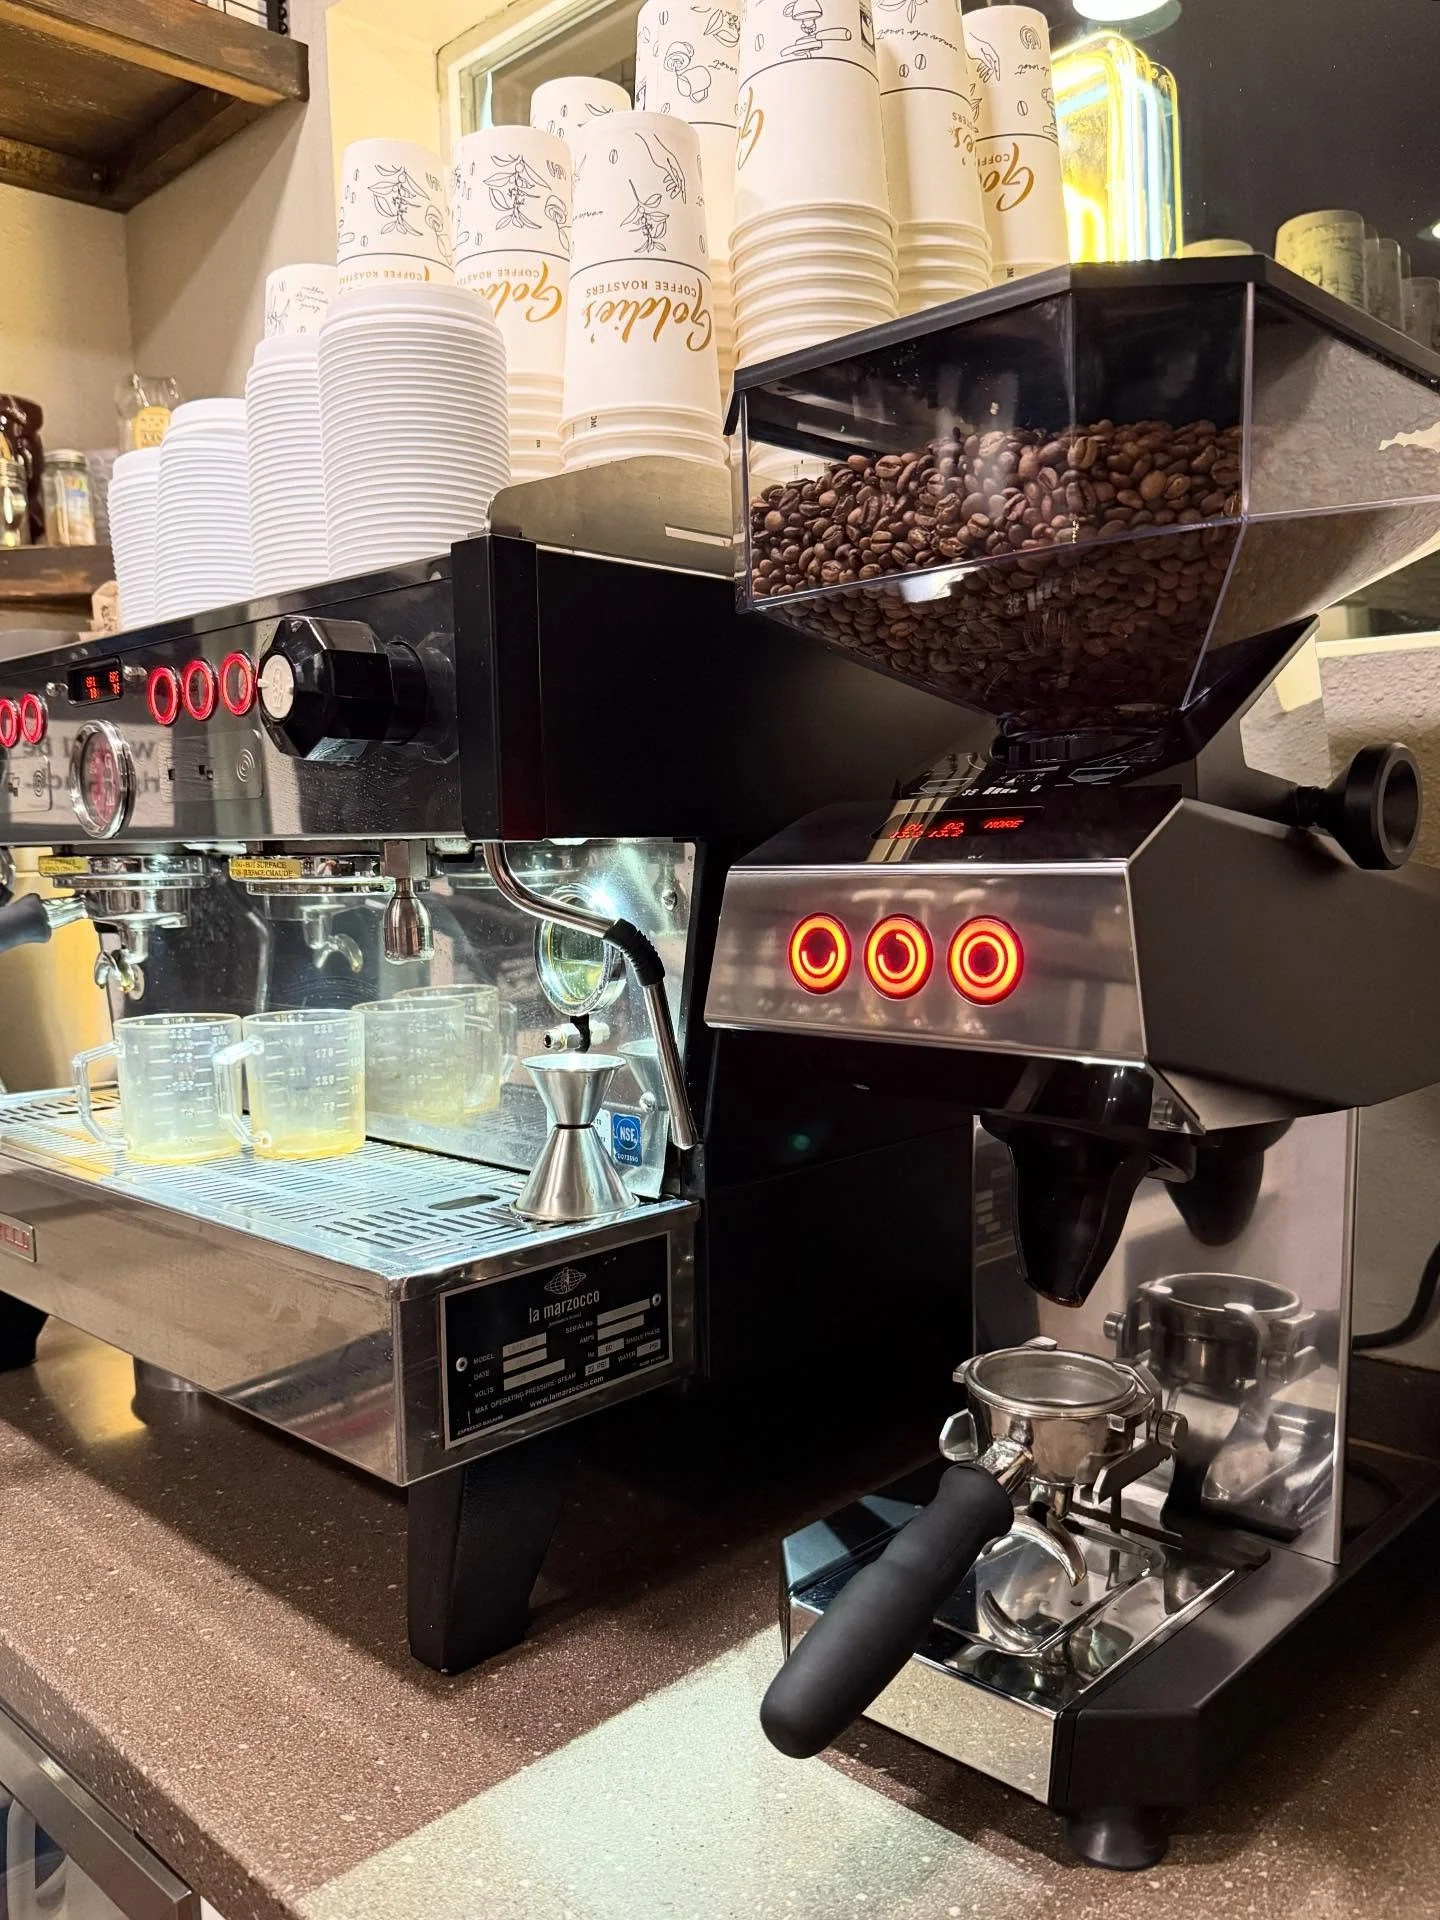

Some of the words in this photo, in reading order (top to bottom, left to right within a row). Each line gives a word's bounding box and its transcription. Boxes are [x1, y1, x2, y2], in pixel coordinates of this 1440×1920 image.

[497, 268, 540, 279] COFFEE
[586, 280, 648, 298] ROASTERS
[655, 280, 697, 298] COFFEE
[582, 278, 712, 352] Goldie's
[984, 819, 1025, 829] MORE
[619, 1126, 637, 1143] NSF
[528, 1307, 540, 1324] la
[543, 1290, 600, 1319] marzocco
[565, 1323, 585, 1334] SERIAL
[617, 1351, 636, 1363] WATER
[529, 1376, 605, 1409] www.lamarzocco.com
[474, 1404, 489, 1415] MAX
